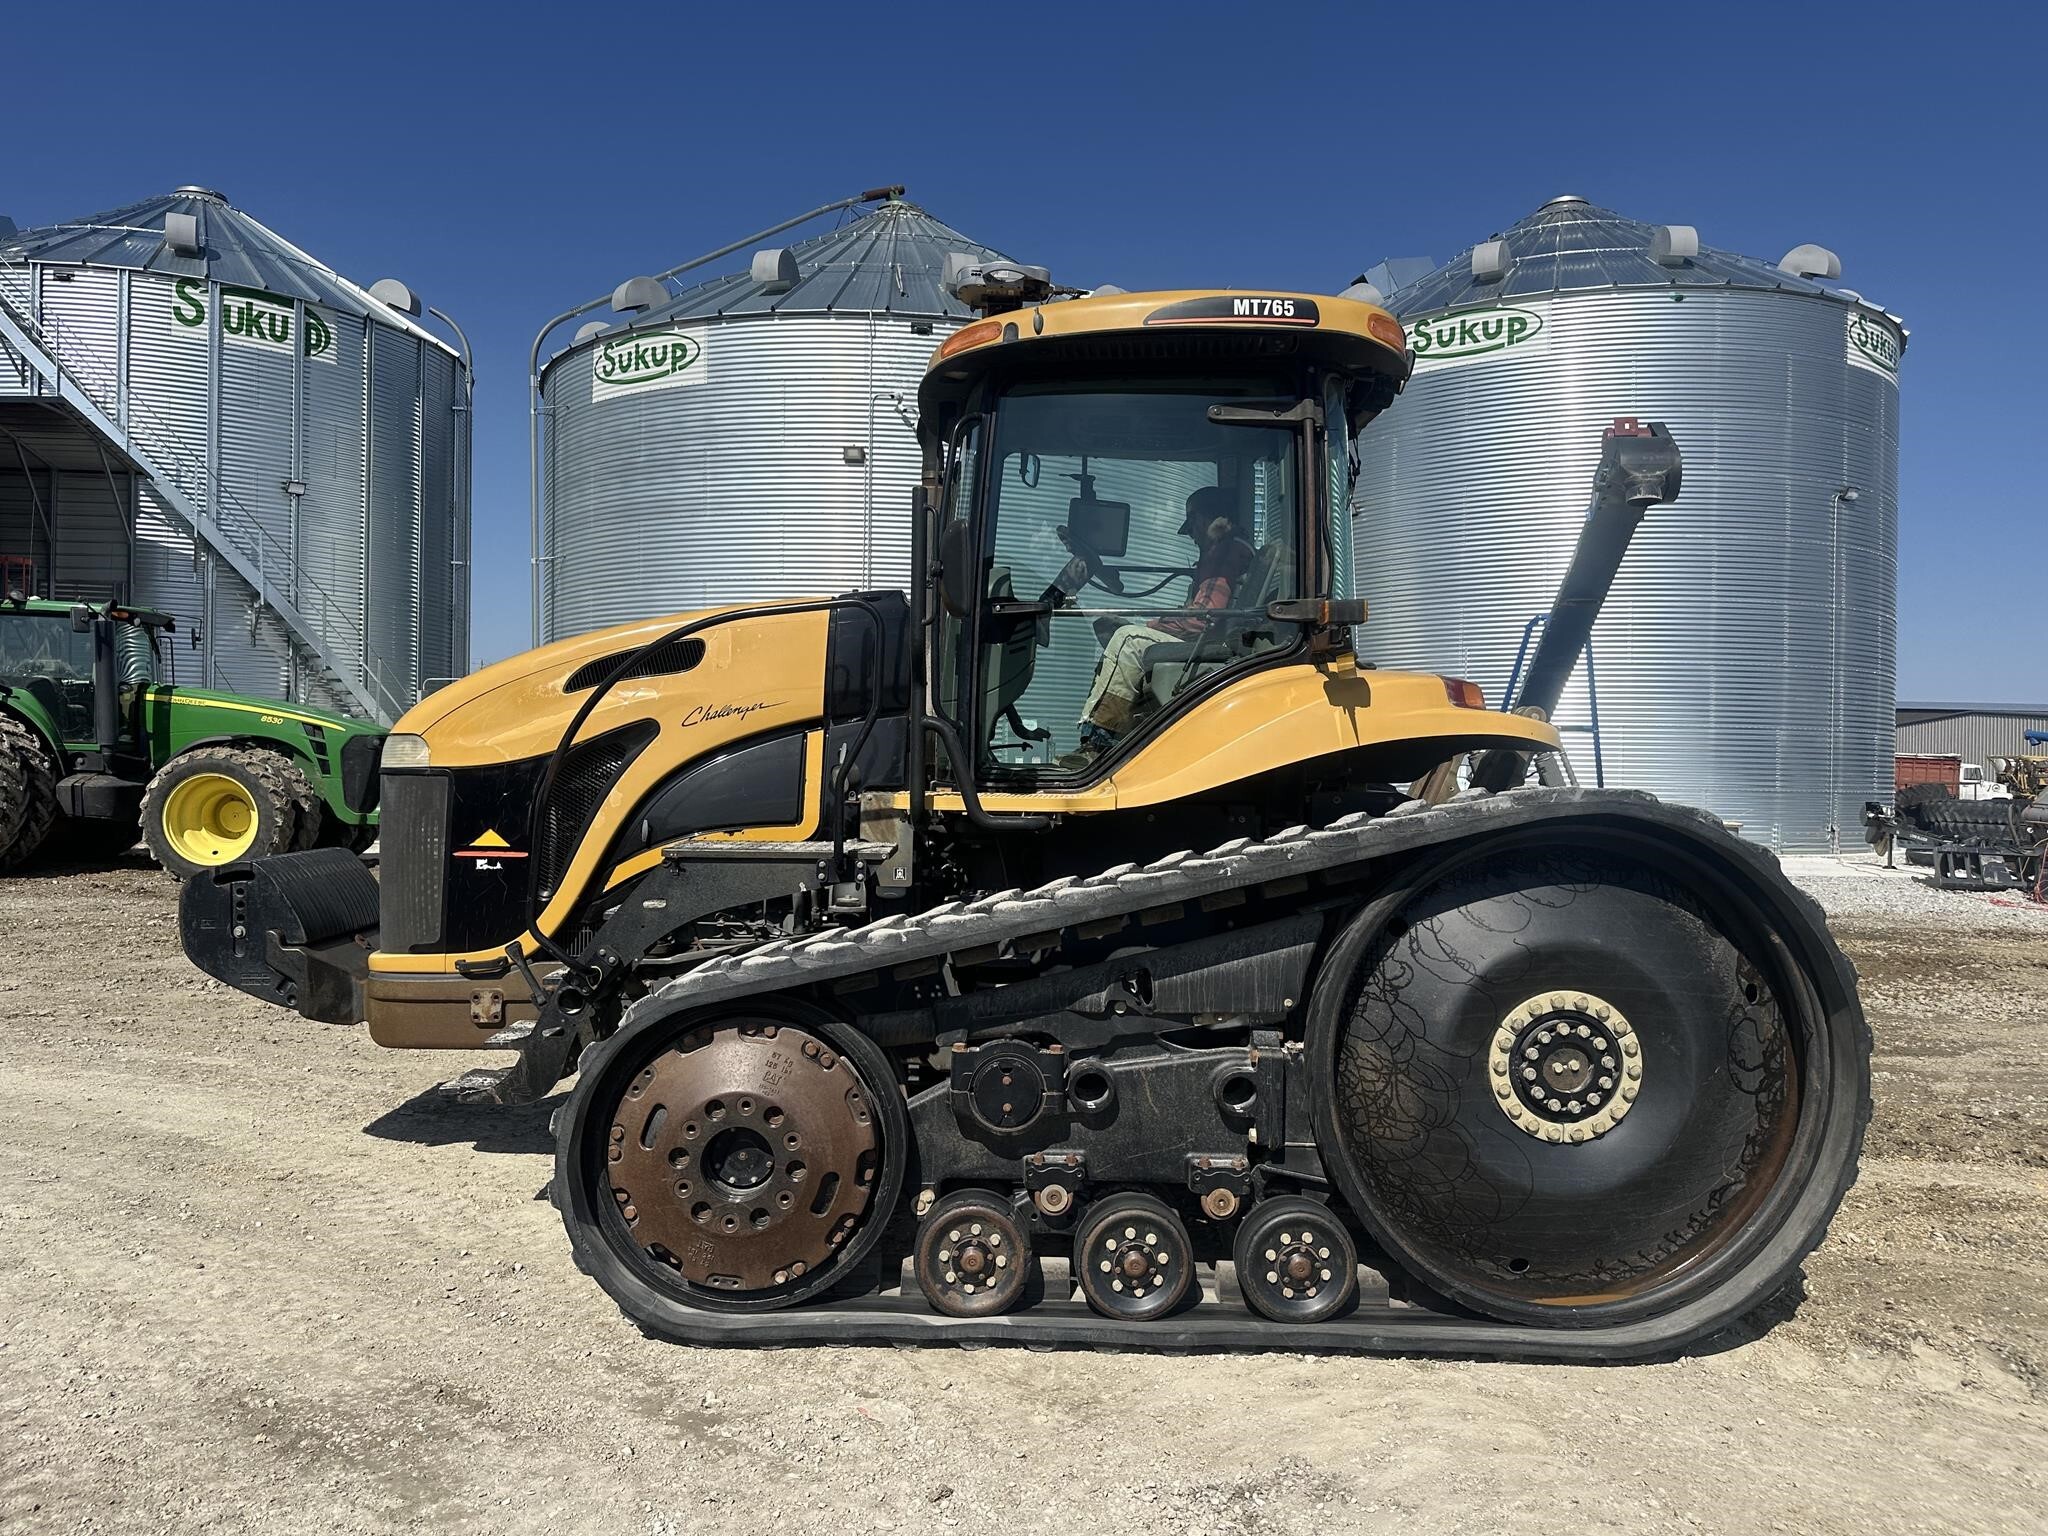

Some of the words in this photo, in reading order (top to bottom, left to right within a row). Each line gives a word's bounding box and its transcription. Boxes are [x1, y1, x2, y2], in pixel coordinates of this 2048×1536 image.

[1233, 298, 1295, 317] MT765
[260, 715, 284, 725] 8530
[681, 699, 793, 728] Challenger
